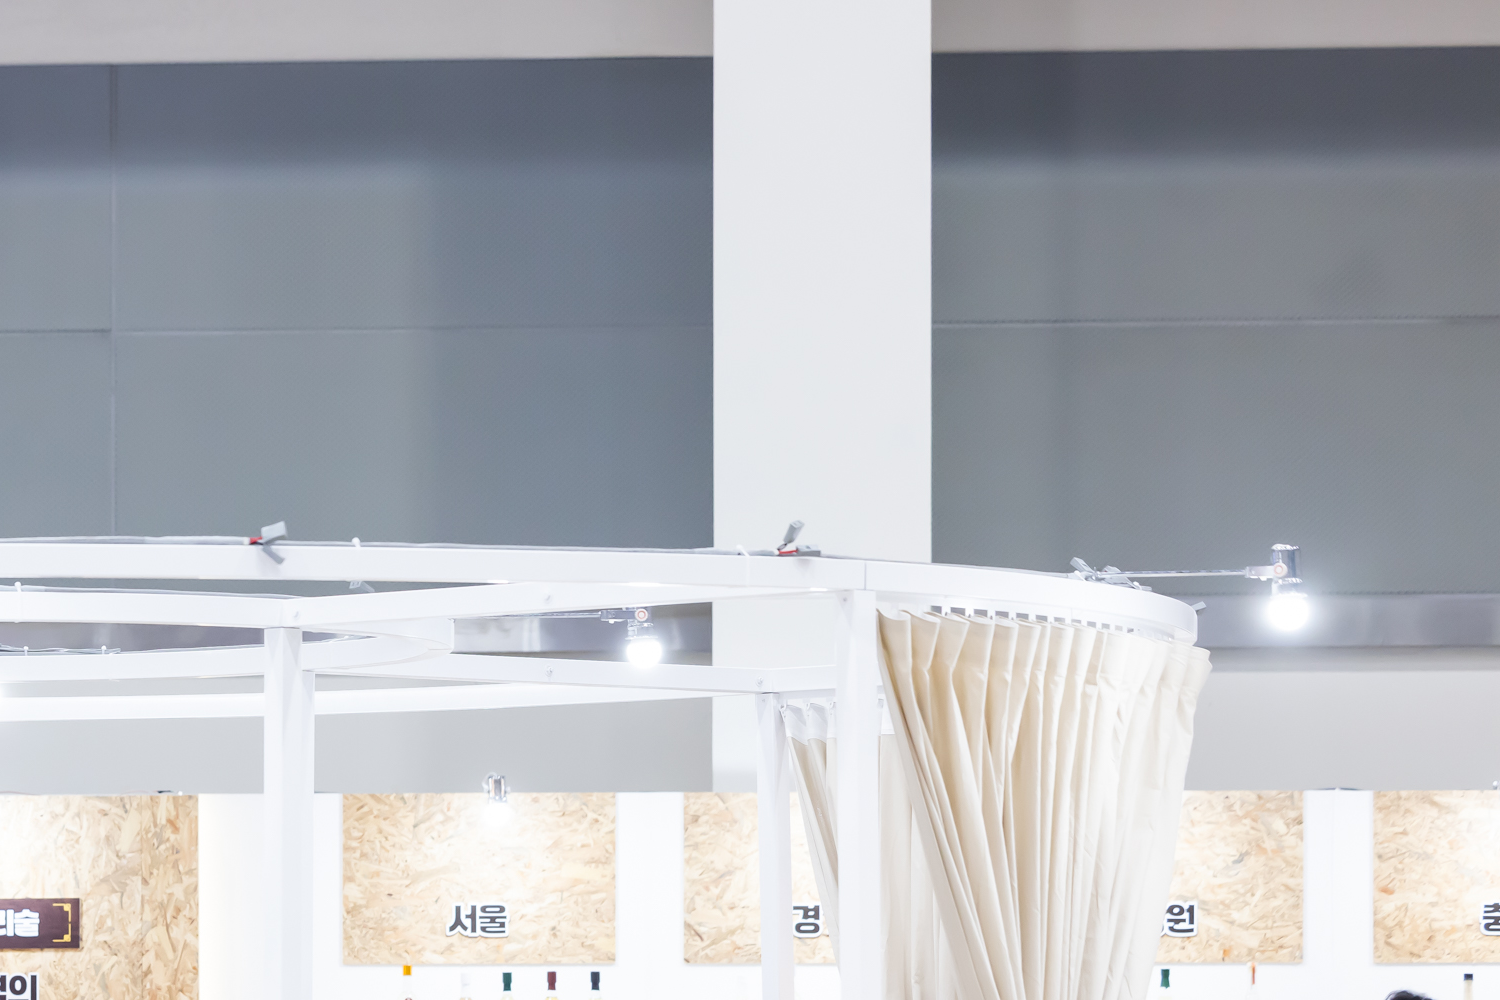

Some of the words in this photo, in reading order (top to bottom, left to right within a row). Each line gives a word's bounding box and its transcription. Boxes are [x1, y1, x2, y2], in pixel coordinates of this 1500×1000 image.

[448, 904, 508, 935] 서울
[792, 905, 821, 934] 경
[1165, 904, 1195, 933] 원
